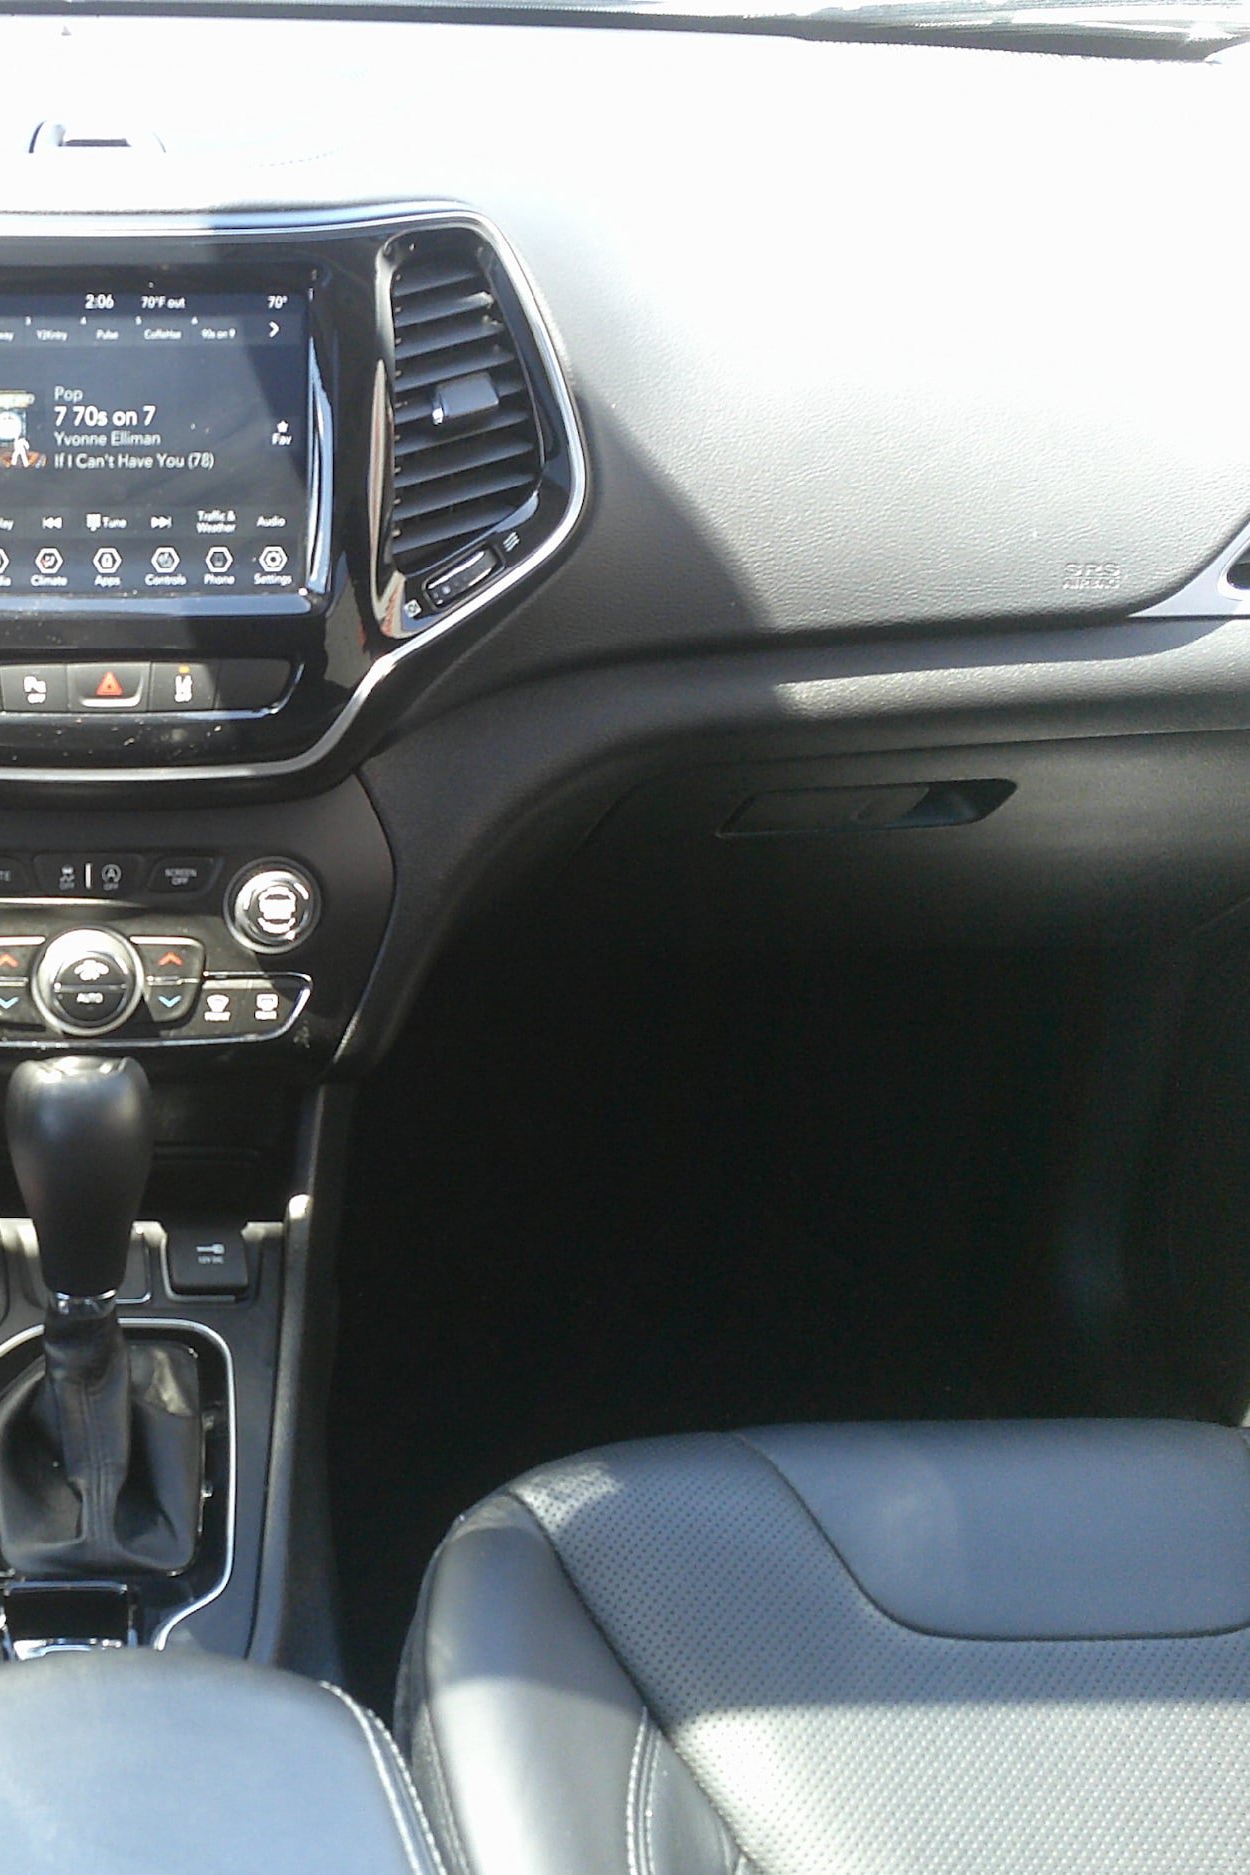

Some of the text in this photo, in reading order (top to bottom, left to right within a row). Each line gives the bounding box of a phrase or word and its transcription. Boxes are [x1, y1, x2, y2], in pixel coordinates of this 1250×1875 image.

[85, 294, 114, 309] 2:06
[167, 296, 185, 309] out
[268, 296, 288, 309] 70°
[54, 385, 83, 403] Pop
[54, 405, 156, 427] 7 70s on 7
[54, 430, 161, 448] Yvonne Elliman
[272, 433, 293, 446] Fav
[54, 453, 65, 469] If
[76, 453, 114, 469] Can't
[118, 453, 153, 469] Have
[156, 453, 185, 469] You
[188, 453, 214, 470] (78)
[102, 516, 127, 529] Tune
[256, 515, 286, 528] Audio
[30, 573, 68, 588] Climate
[94, 574, 121, 588] Apps
[145, 573, 187, 587] Controls
[203, 573, 235, 586] Phone
[253, 572, 293, 587] Settings
[165, 868, 198, 878] SCREEN
[171, 877, 189, 886] OFF
